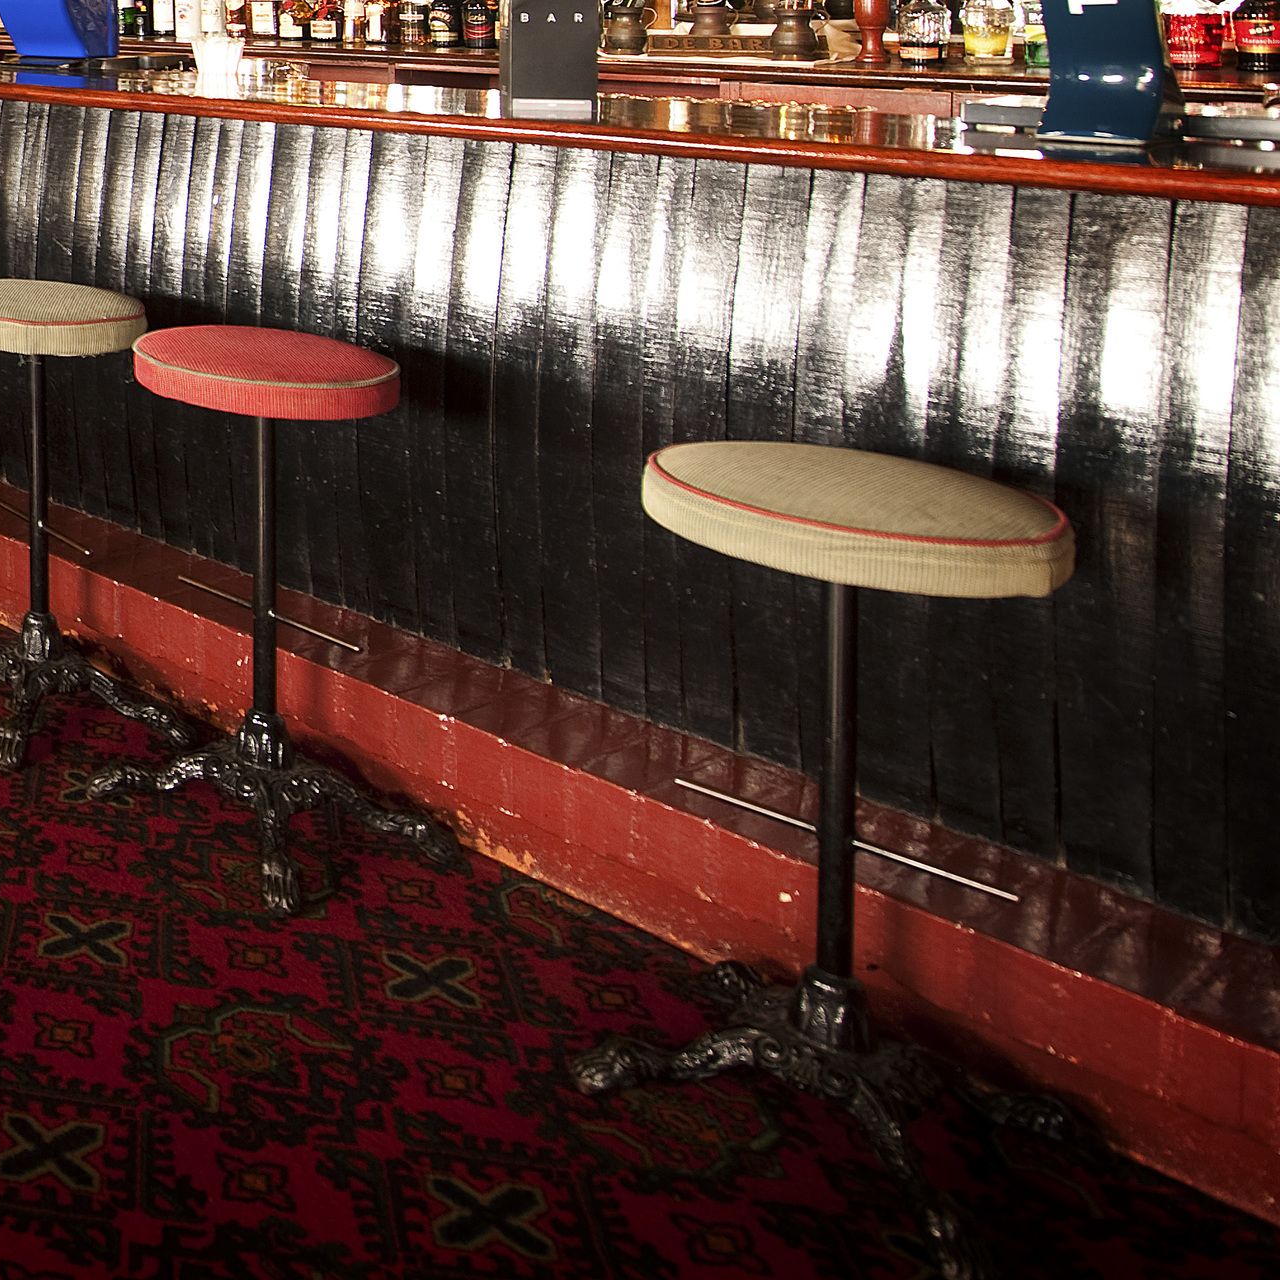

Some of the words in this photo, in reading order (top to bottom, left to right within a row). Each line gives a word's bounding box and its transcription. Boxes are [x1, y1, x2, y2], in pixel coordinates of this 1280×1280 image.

[519, 12, 584, 23] BAR
[665, 37, 691, 49] DE
[708, 37, 764, 51] BAR
